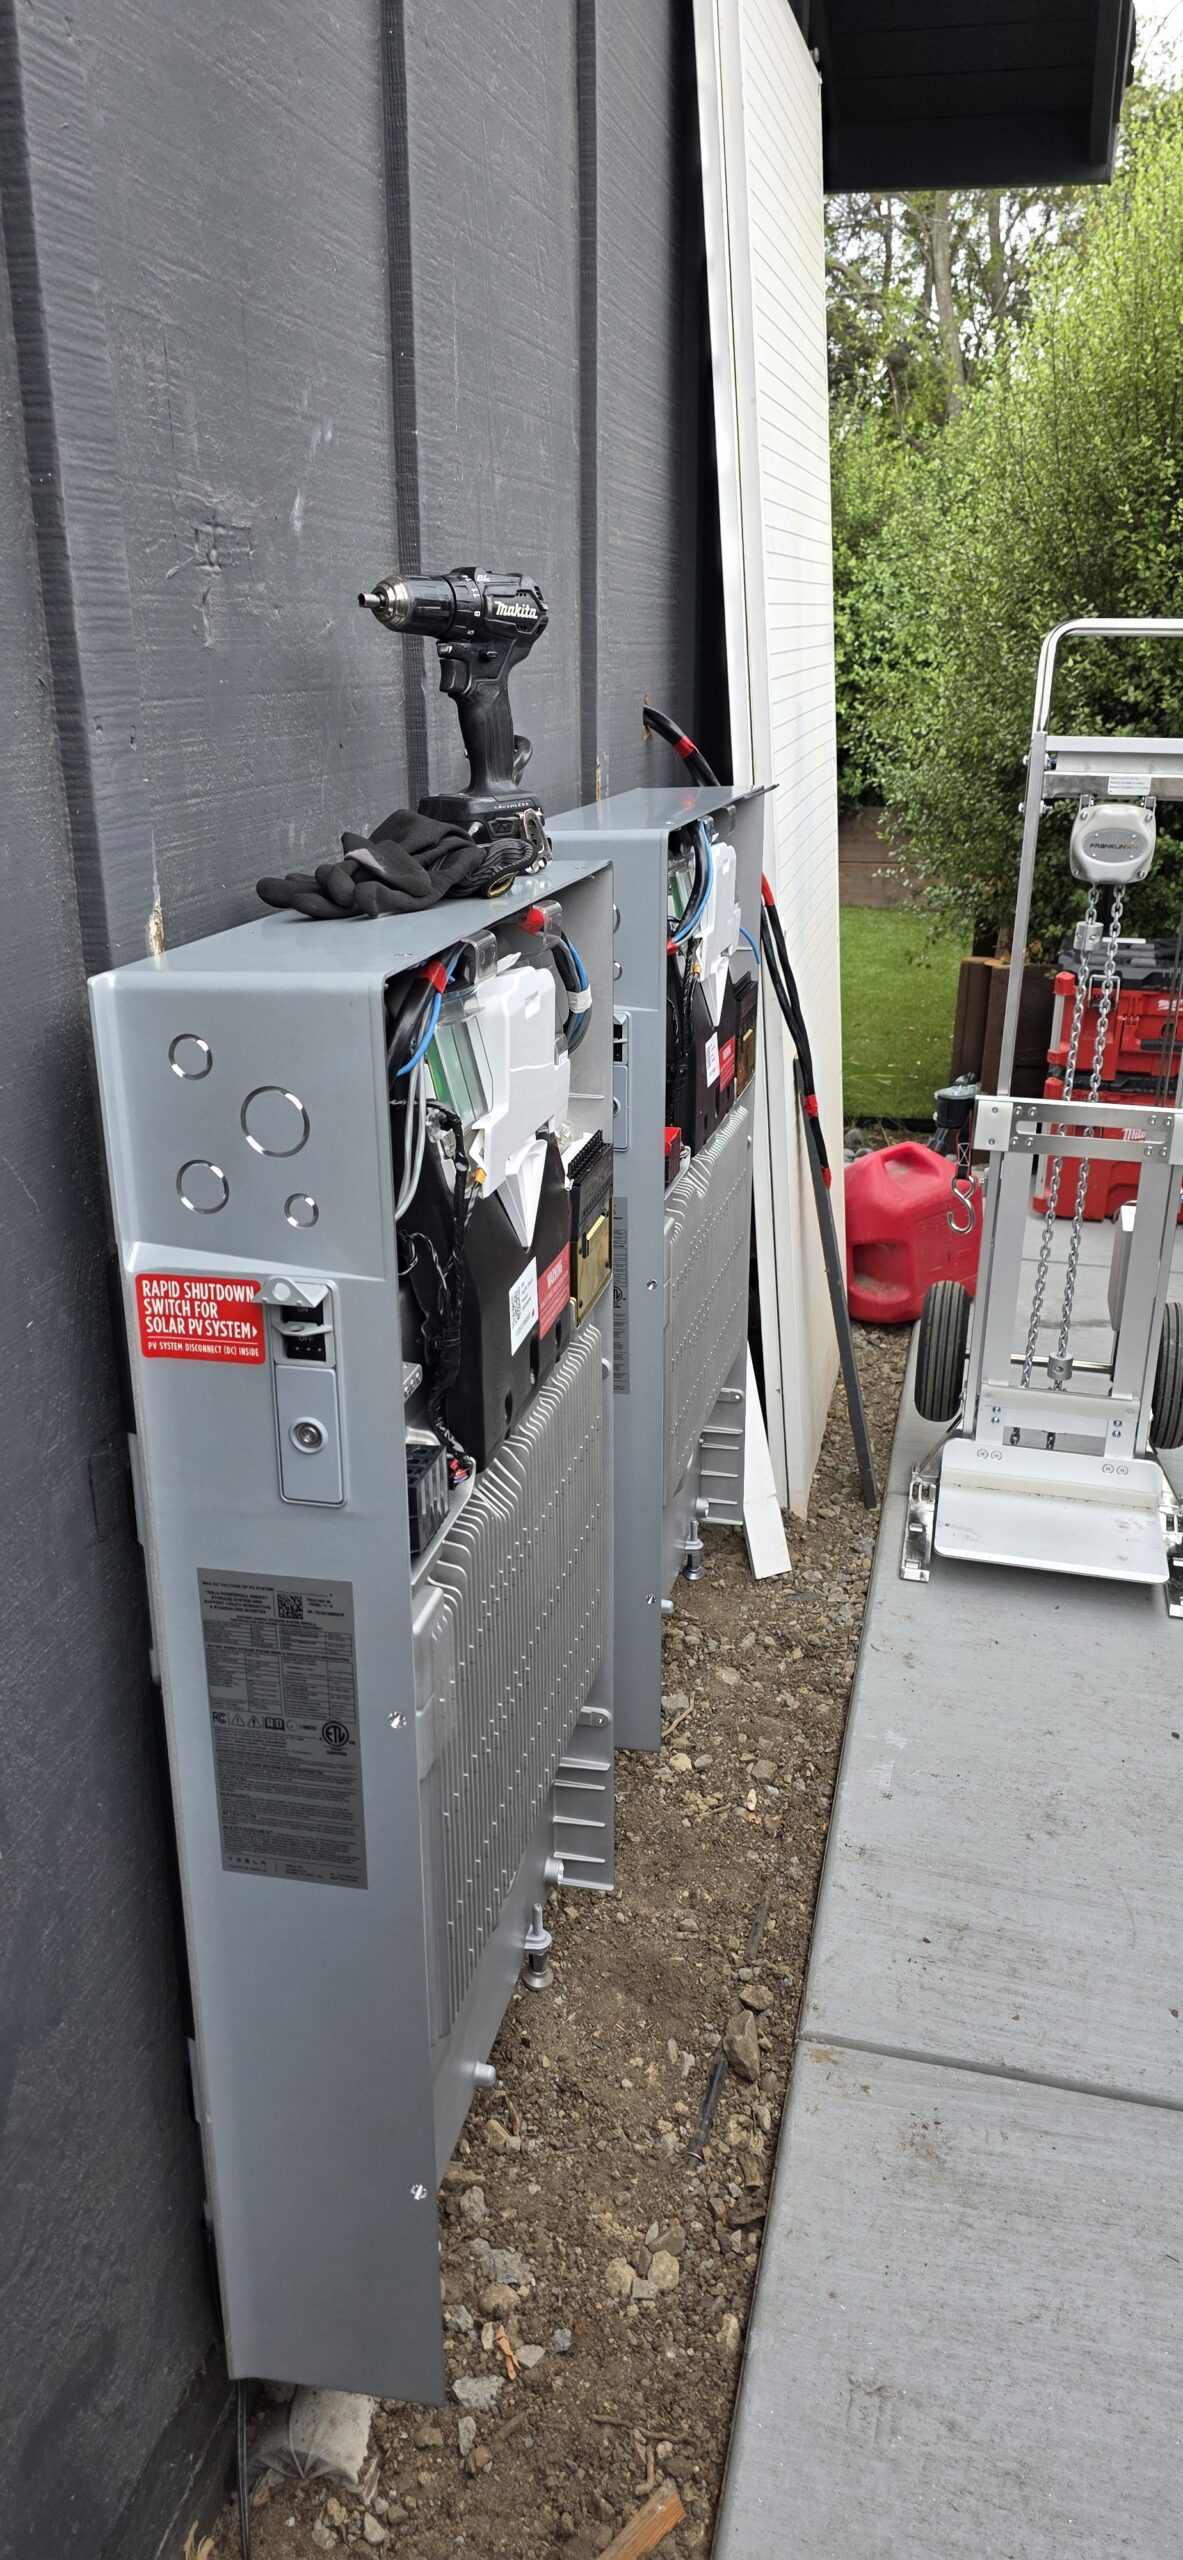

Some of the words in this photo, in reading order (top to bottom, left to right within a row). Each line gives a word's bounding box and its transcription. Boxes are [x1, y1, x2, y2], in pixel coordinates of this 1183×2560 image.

[476, 574, 491, 582] BL
[494, 600, 539, 620] Makita
[142, 1279, 180, 1298] RAPID
[183, 1281, 255, 1303] SHUTDOWN
[143, 1298, 191, 1317] SWITCH
[194, 1301, 219, 1319] FOR
[145, 1316, 186, 1335] SOLAR
[188, 1318, 203, 1336] PV
[205, 1319, 251, 1339] SYSTEM
[147, 1341, 157, 1350] PV
[159, 1342, 183, 1351] SYSTEM
[185, 1343, 222, 1355] DISCONNECT
[223, 1345, 237, 1356] (DC)
[238, 1347, 260, 1357] INSIDE
